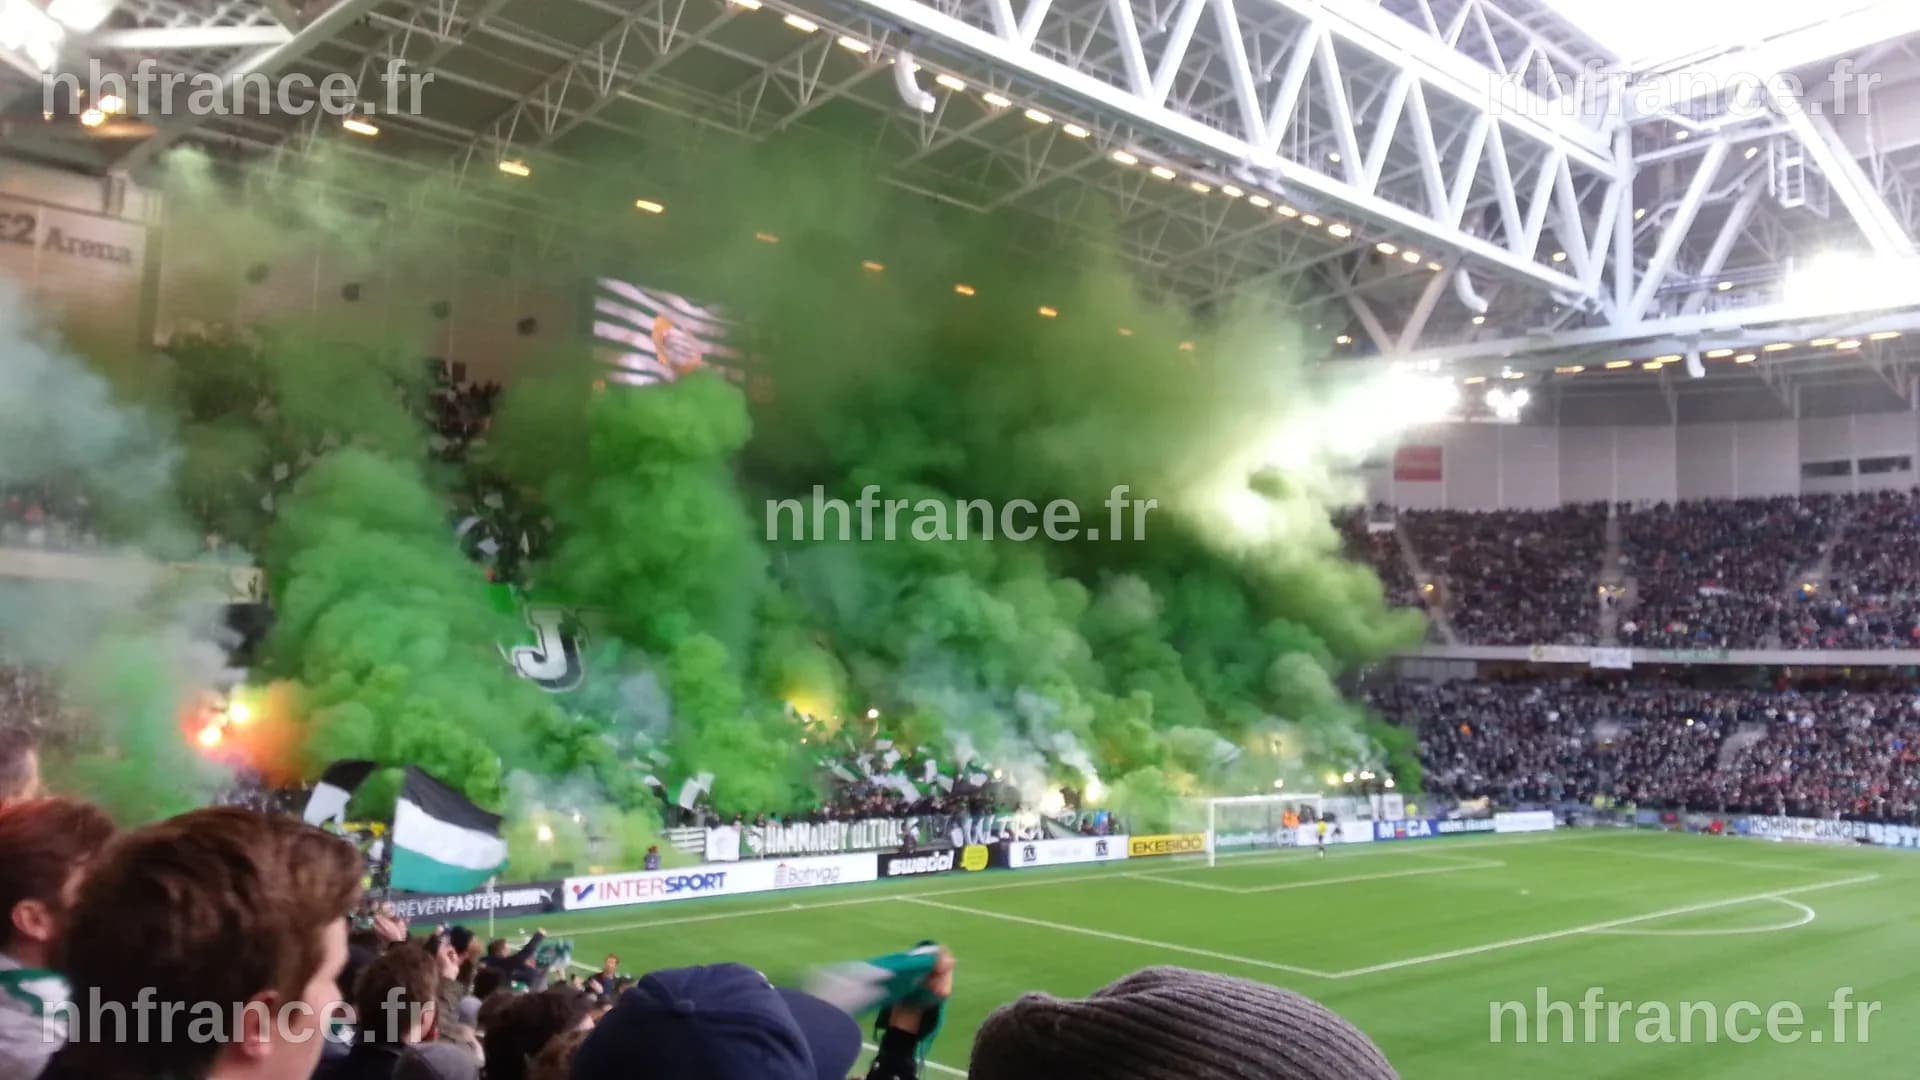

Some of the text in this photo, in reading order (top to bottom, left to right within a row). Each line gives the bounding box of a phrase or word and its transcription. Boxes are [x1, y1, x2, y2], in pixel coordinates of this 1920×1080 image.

[42, 226, 133, 264] Arena
[888, 851, 954, 876] swedol
[599, 871, 727, 901] INTERSPORT
